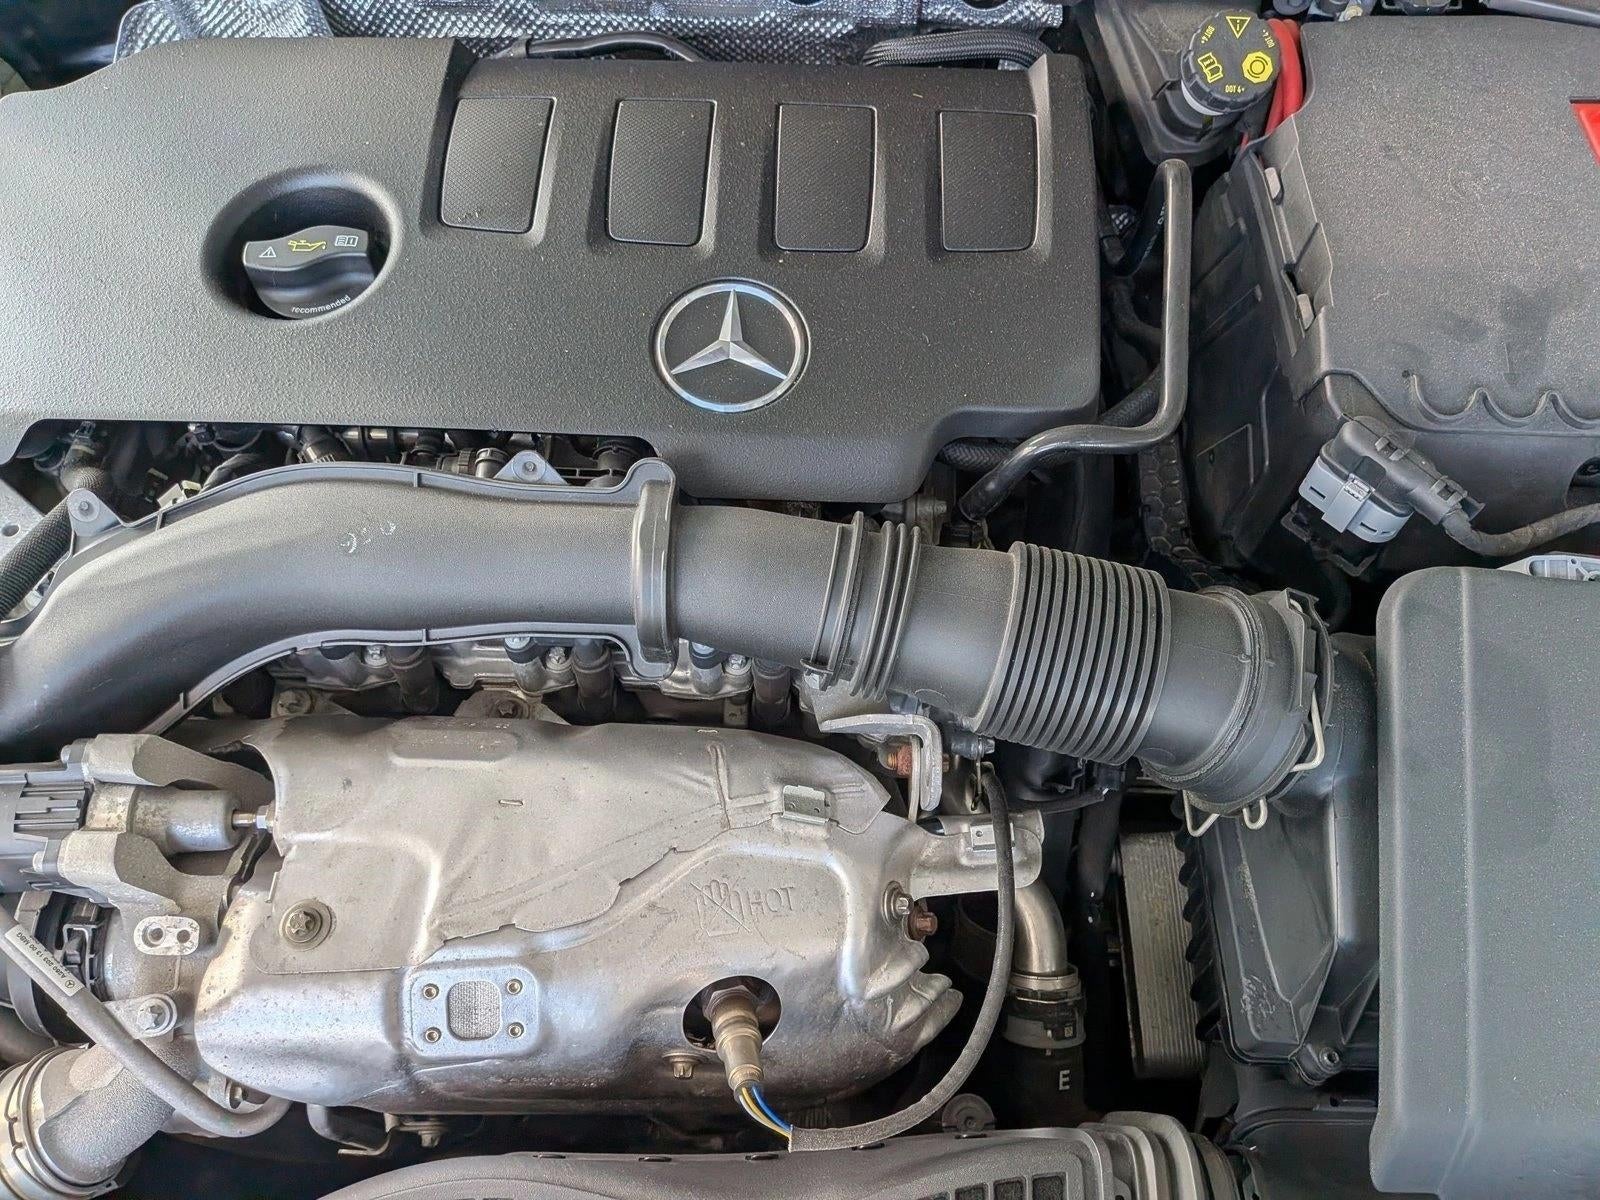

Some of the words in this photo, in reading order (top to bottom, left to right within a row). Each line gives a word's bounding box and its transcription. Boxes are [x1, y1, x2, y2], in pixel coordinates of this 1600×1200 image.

[1225, 85, 1236, 93] DOT
[291, 294, 351, 314] recommended
[746, 886, 794, 915] HOT
[1059, 1070, 1070, 1090] E
